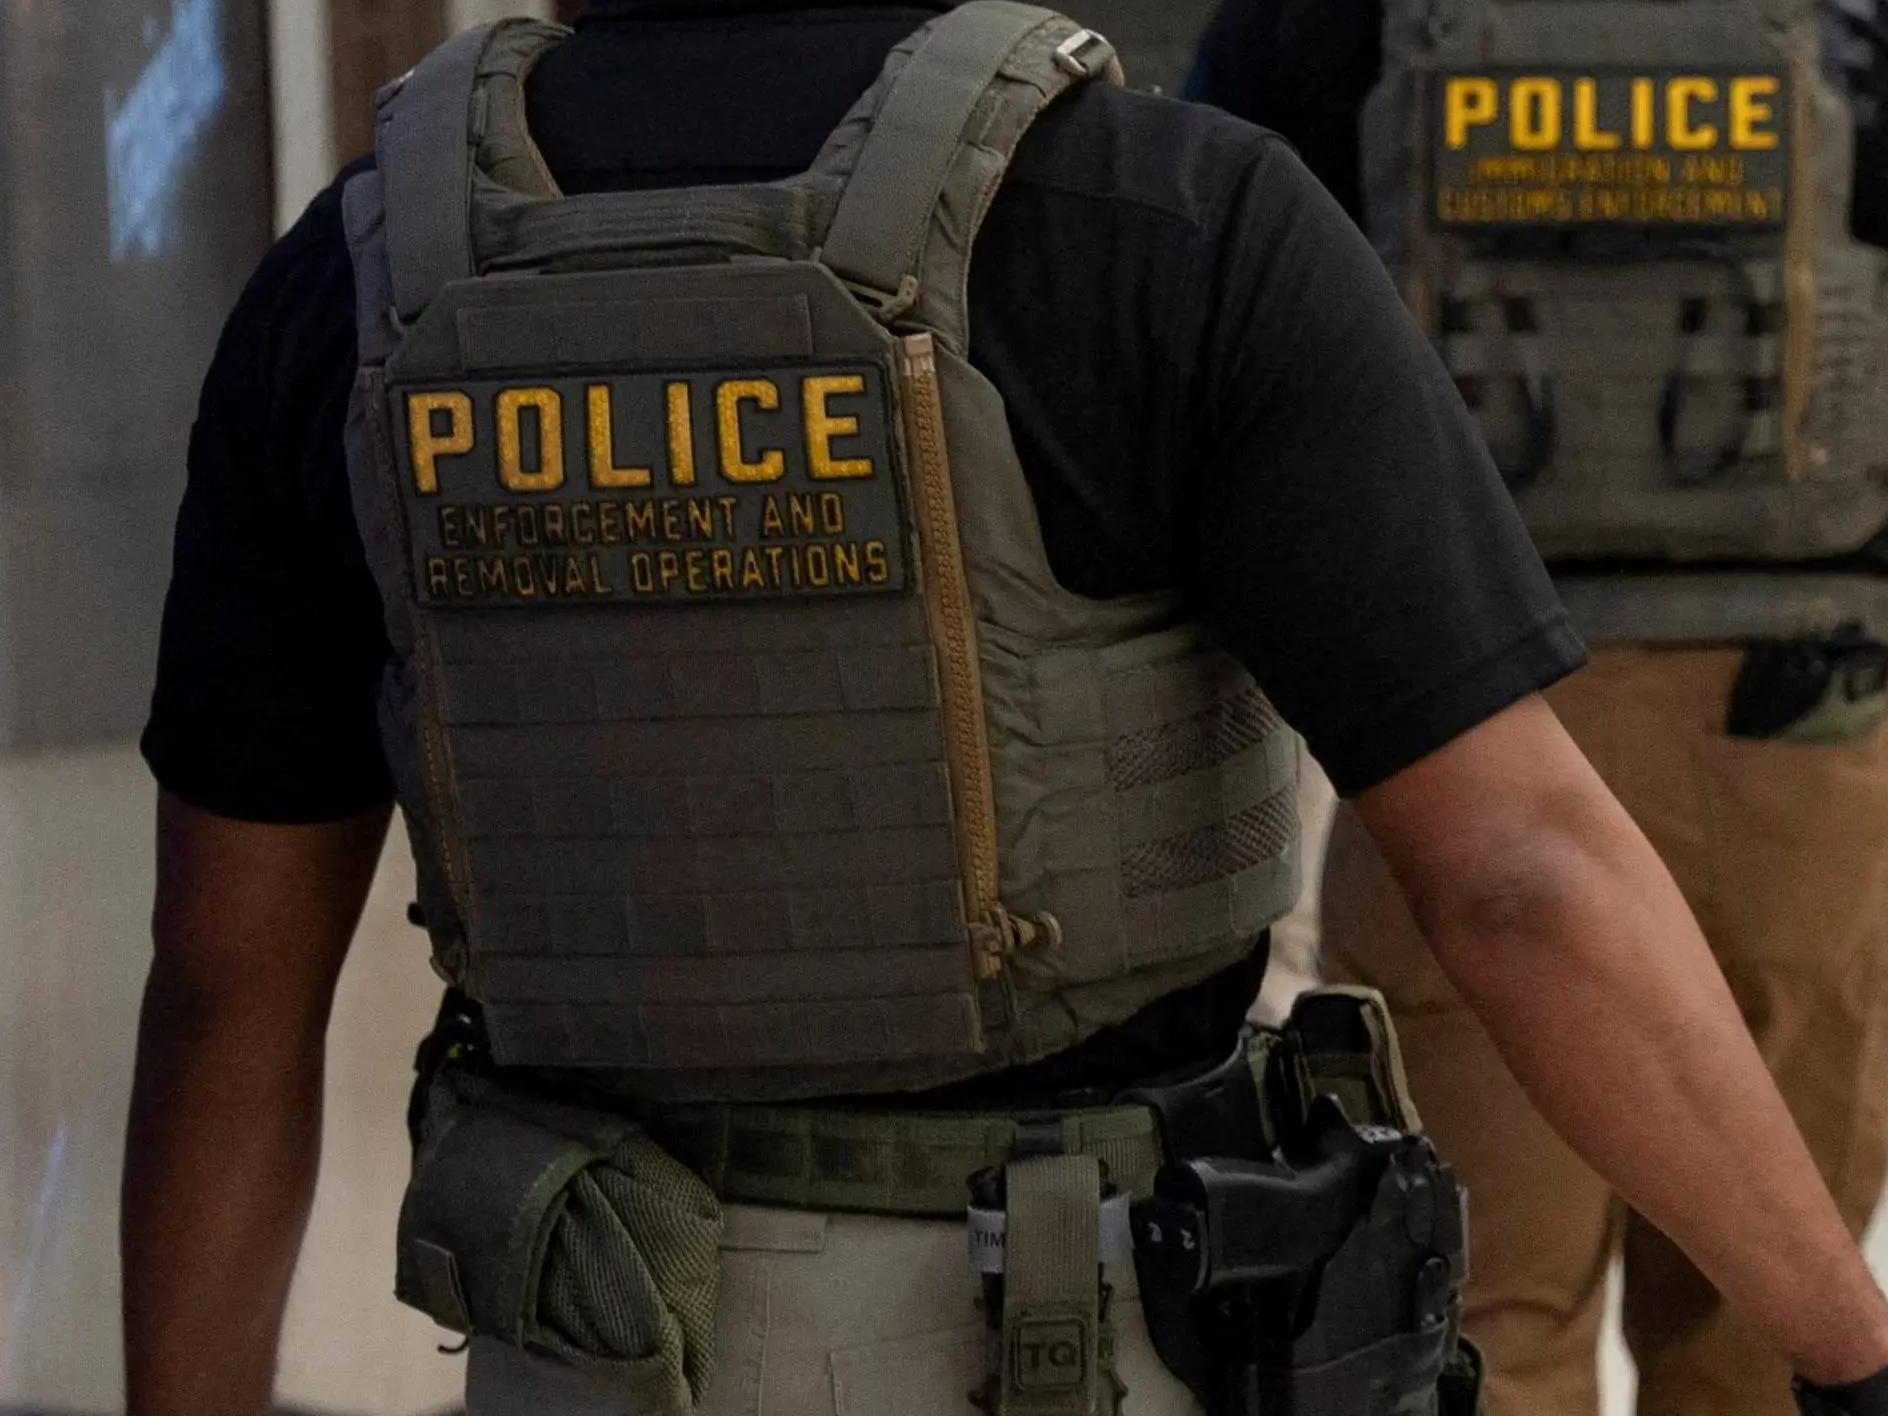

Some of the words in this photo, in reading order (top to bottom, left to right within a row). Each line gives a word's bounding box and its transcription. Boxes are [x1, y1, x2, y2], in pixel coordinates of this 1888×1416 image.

[1444, 75, 1780, 150] POLICE
[1682, 155, 1744, 185] AND
[406, 374, 874, 493] POLICE
[439, 497, 738, 547] ENFORCEMENT
[762, 492, 844, 538] AND
[427, 550, 612, 598] REMOVAL
[630, 541, 888, 594] OPERATIONS
[1022, 1340, 1077, 1370] TQ
